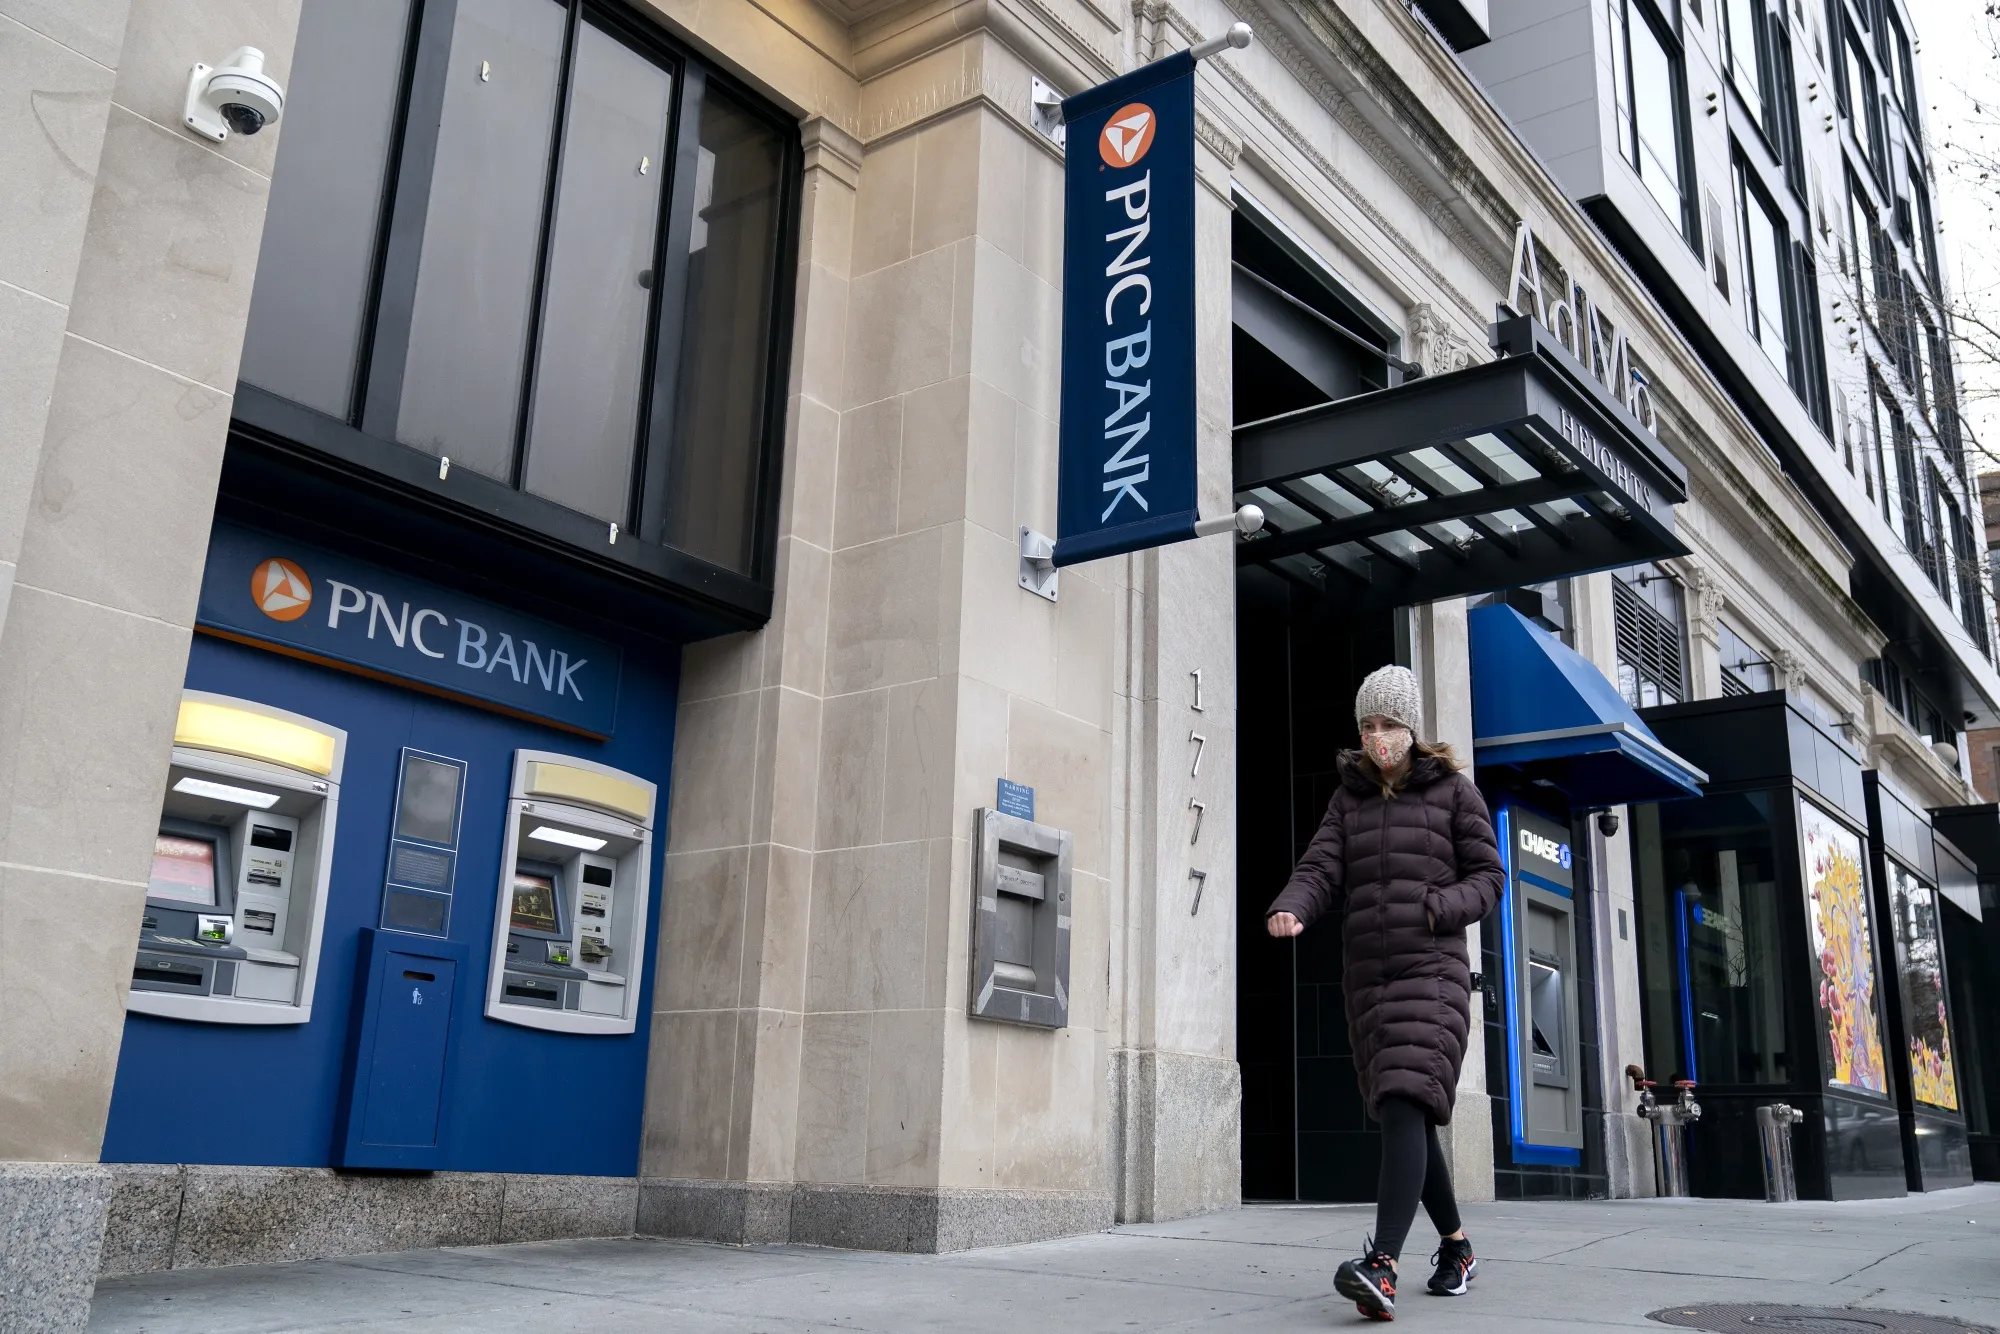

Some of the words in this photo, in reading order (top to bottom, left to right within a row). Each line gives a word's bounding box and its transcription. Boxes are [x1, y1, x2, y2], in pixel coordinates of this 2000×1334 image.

[1558, 406, 1652, 514] HEIGHTS
[1003, 782, 1030, 795] WARNING
[1520, 829, 1560, 863] CHASE
